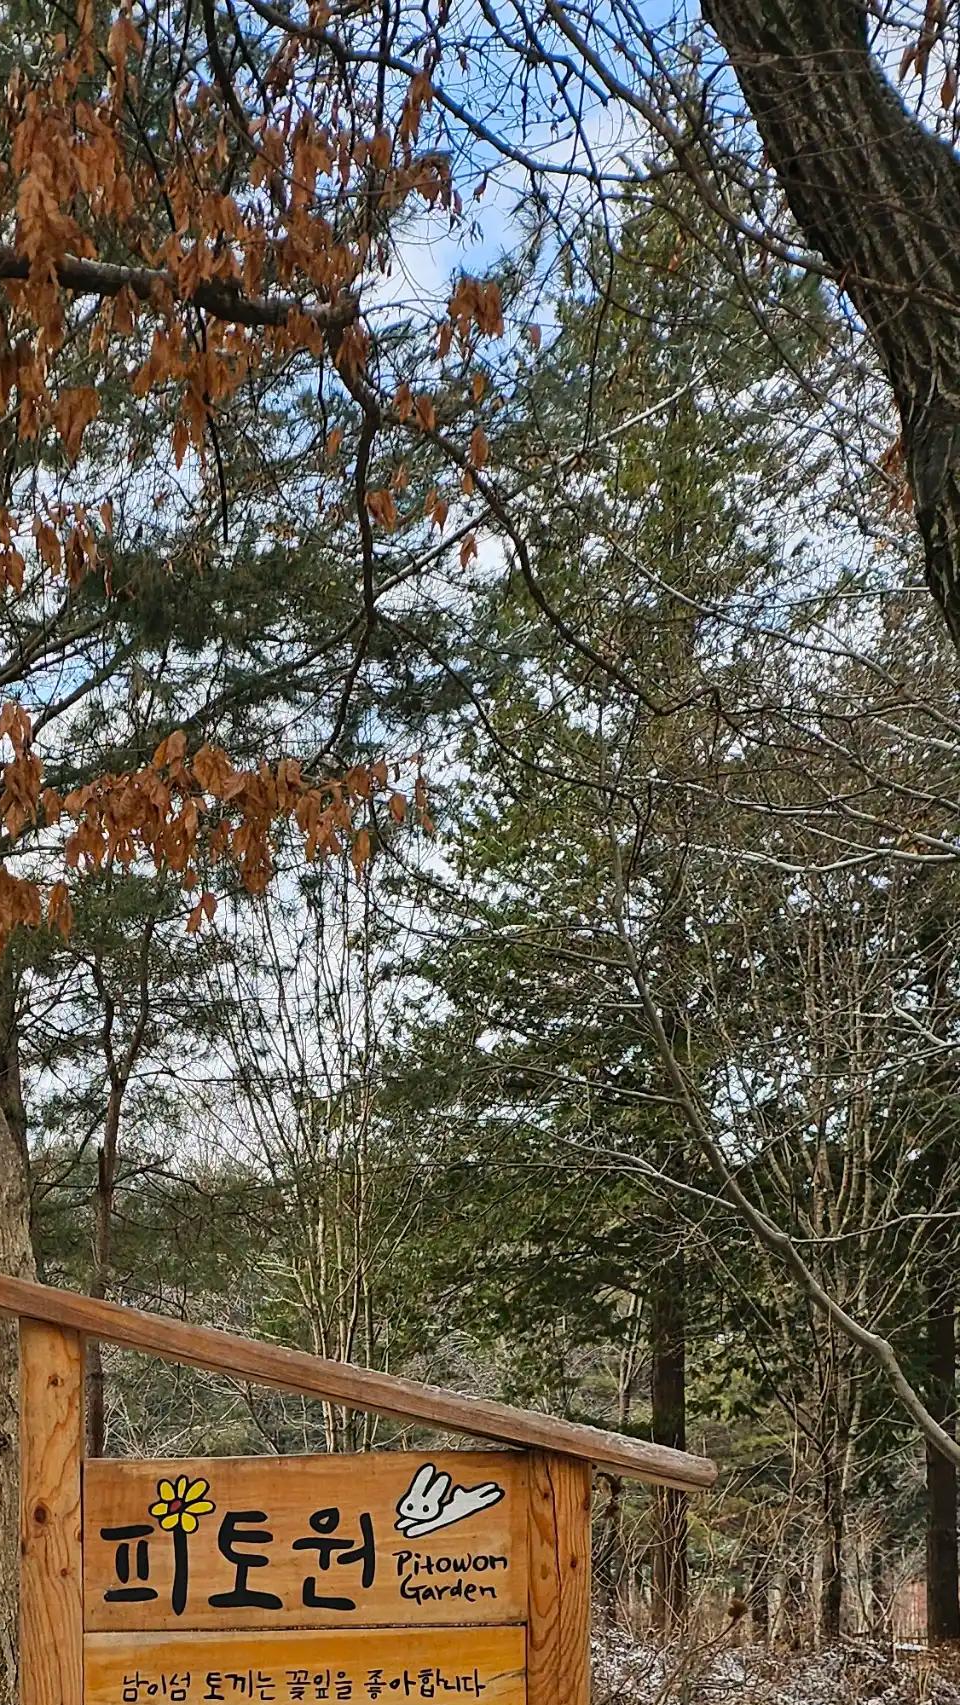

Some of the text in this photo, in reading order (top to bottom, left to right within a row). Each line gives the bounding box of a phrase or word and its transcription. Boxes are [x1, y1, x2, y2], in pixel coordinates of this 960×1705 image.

[99, 1507, 376, 1616] 피토원
[392, 1550, 508, 1577] Pitowon
[400, 1574, 497, 1604] Garden
[123, 1668, 486, 1702] 남이섬 토끼는 꽃잎을 좋아합니다
